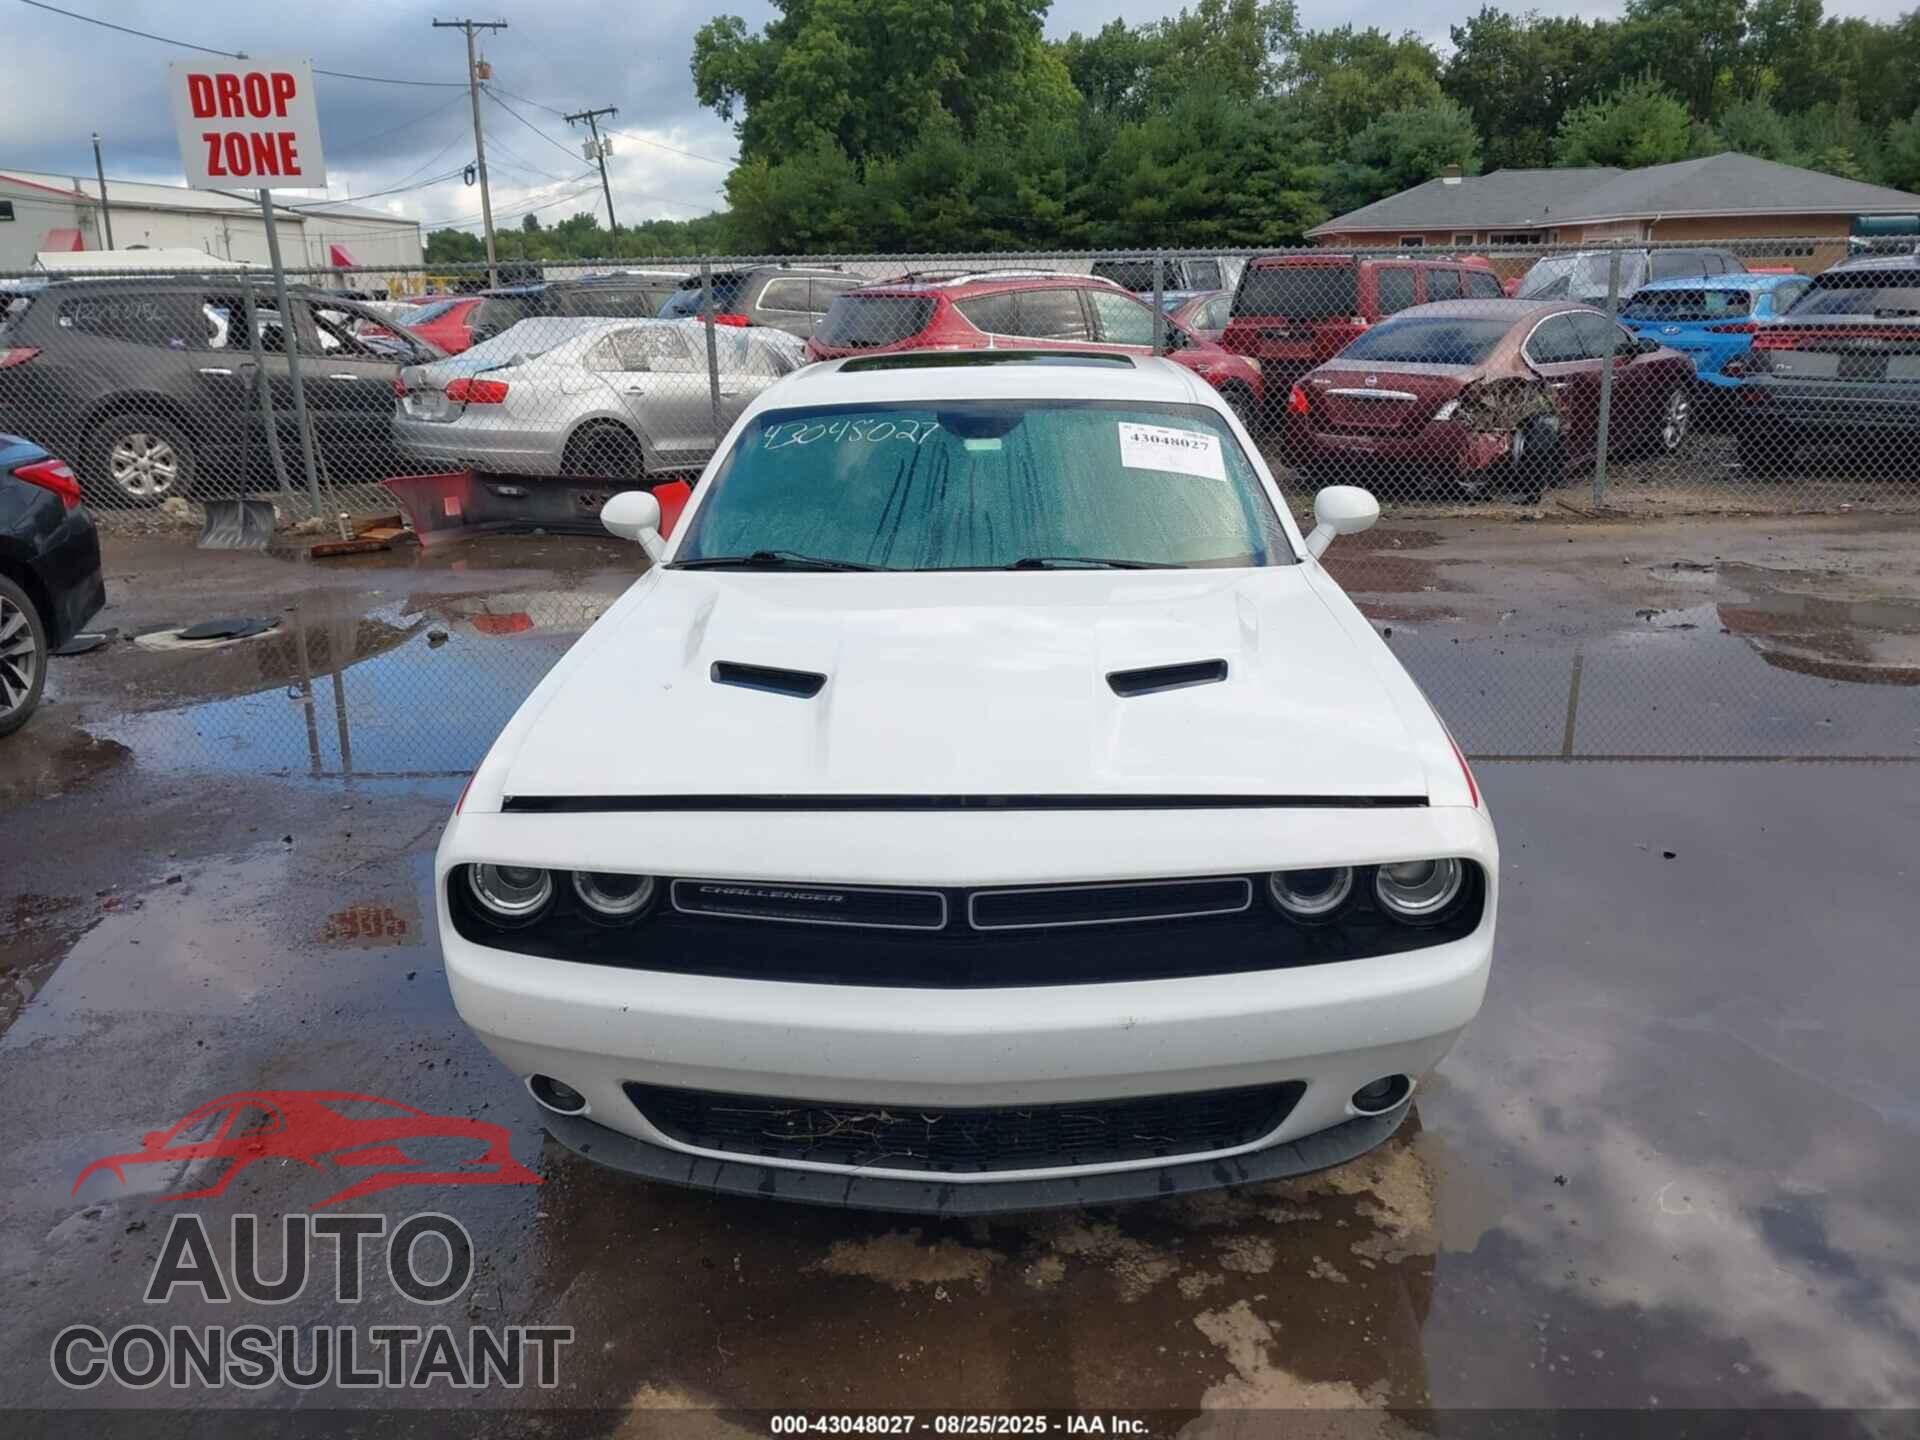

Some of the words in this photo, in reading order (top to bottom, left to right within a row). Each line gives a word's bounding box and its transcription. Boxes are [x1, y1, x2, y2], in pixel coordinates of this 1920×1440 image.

[187, 72, 296, 118] DROP
[202, 132, 301, 176] ZONE
[1130, 433, 1209, 451] 43048027
[699, 886, 844, 902] CHALLENGER
